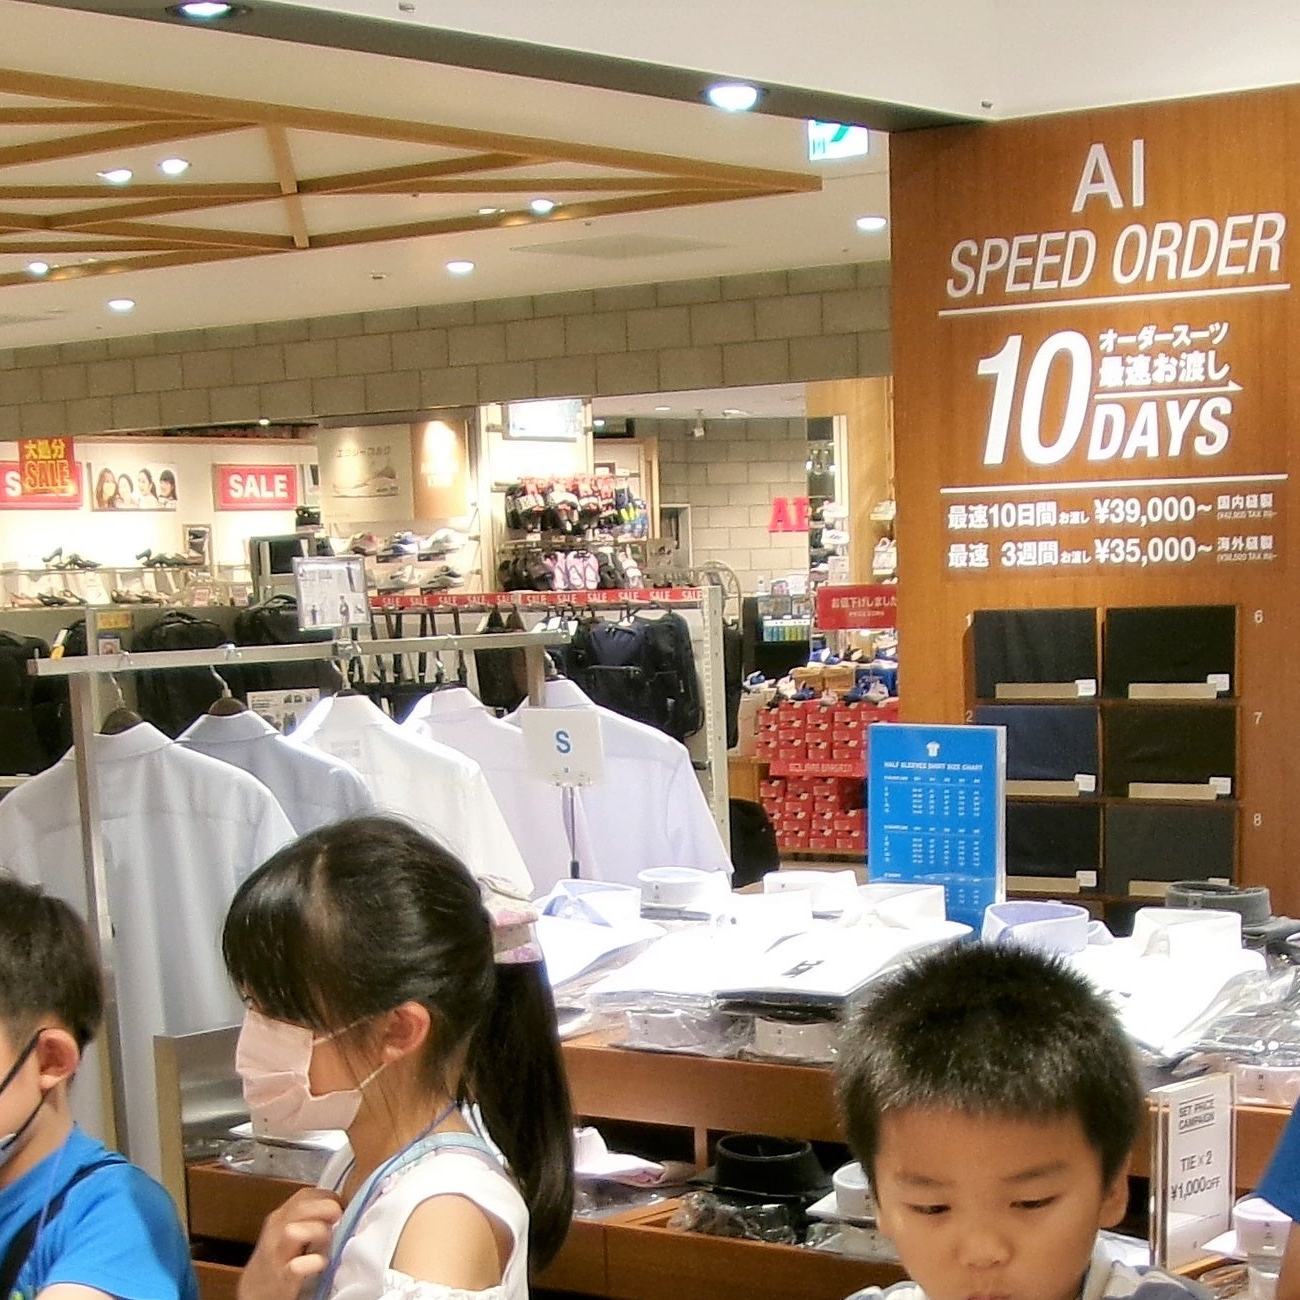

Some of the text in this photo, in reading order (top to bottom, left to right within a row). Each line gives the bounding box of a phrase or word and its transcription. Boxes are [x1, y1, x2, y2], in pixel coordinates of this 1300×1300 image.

[1071, 139, 1146, 213] AI
[947, 212, 1286, 298] SPEED ORDER
[1099, 321, 1230, 352] オーダースーツ
[1098, 353, 1231, 387] 最速お渡し
[977, 330, 1232, 465] 10 DAYS
[25, 460, 70, 488] SALE
[229, 473, 289, 498] SALE
[947, 543, 990, 568] 最速
[382, 597, 400, 607] SALE
[409, 597, 428, 606] SALE
[439, 596, 458, 606] SALE
[468, 595, 486, 605] SALE
[497, 594, 515, 604] SALE
[527, 594, 547, 604] SALE
[557, 593, 577, 603] SALE
[587, 592, 608, 603] SALE
[618, 592, 639, 602] SALE
[649, 590, 670, 601] SALE
[682, 590, 702, 600] SALE
[1254, 610, 1264, 624] 6
[965, 711, 973, 723] 2
[1254, 712, 1262, 725] 7
[555, 730, 571, 754] S
[1253, 813, 1261, 826] 8
